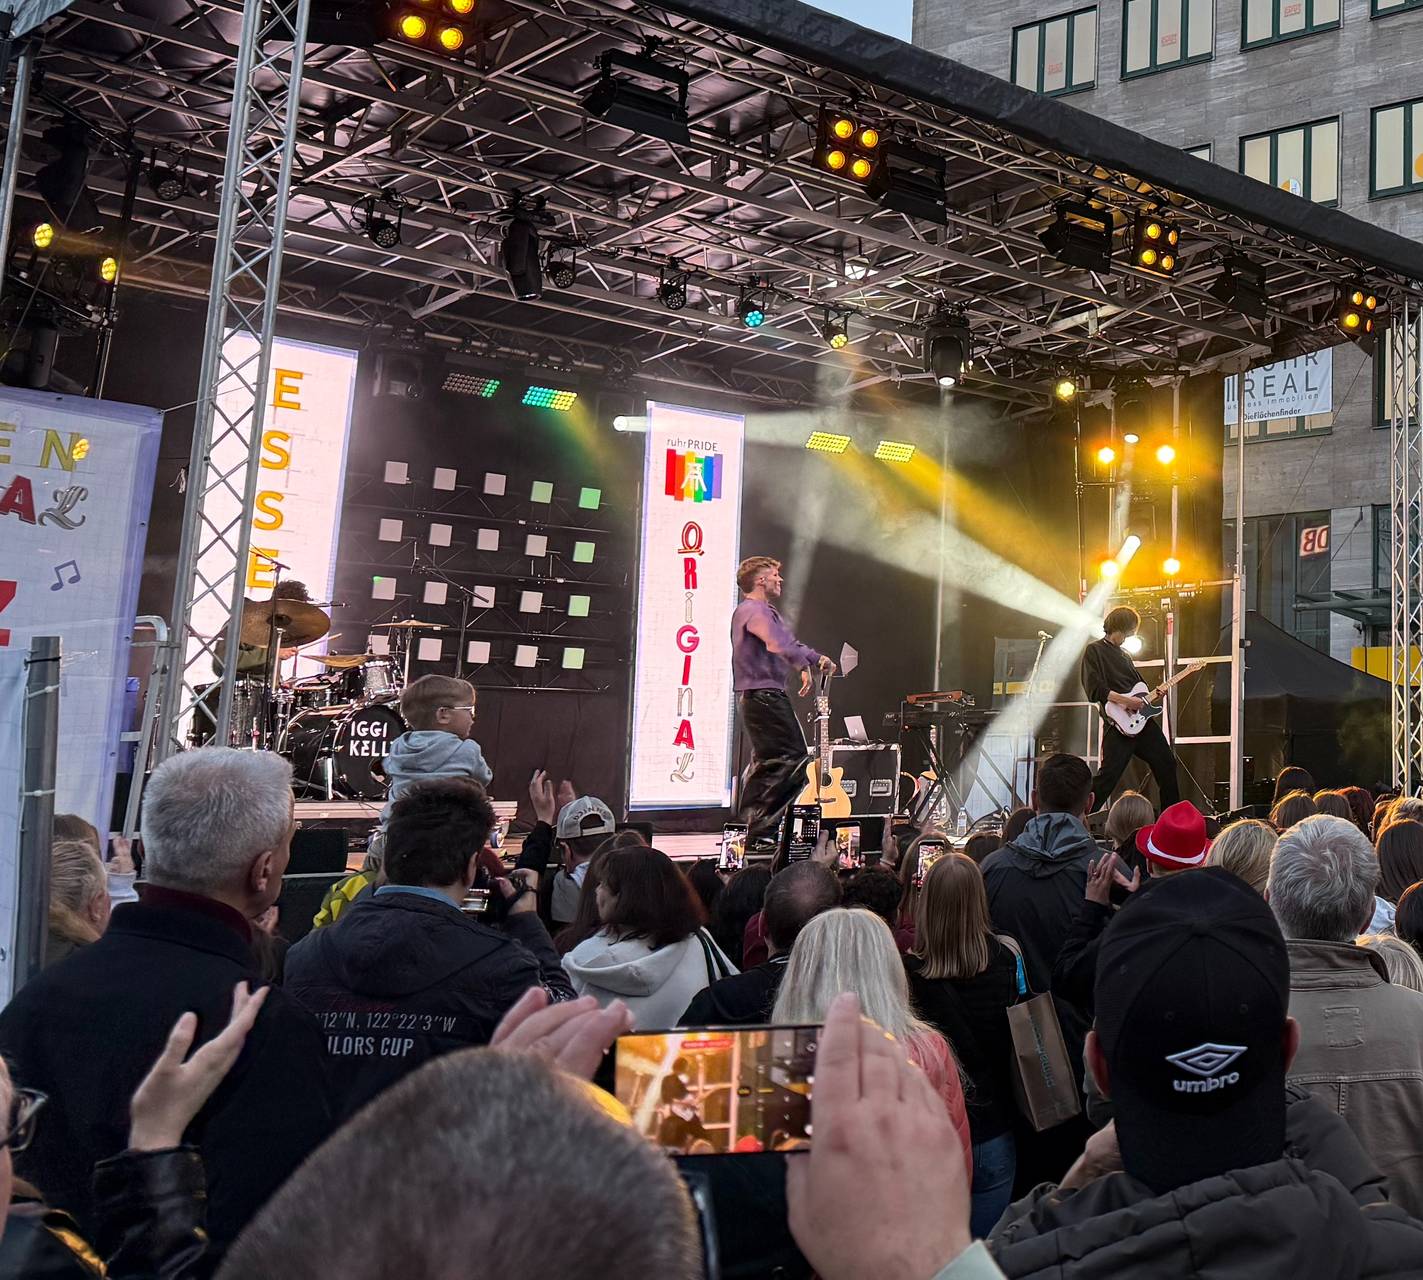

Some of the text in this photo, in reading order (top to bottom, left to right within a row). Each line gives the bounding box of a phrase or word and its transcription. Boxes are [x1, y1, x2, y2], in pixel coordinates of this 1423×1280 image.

[1244, 370, 1318, 399] REAL
[350, 720, 388, 738] IGGI
[349, 740, 394, 757] KELL
[380, 1037, 414, 1057] CUP
[1173, 1071, 1240, 1093] umbro
